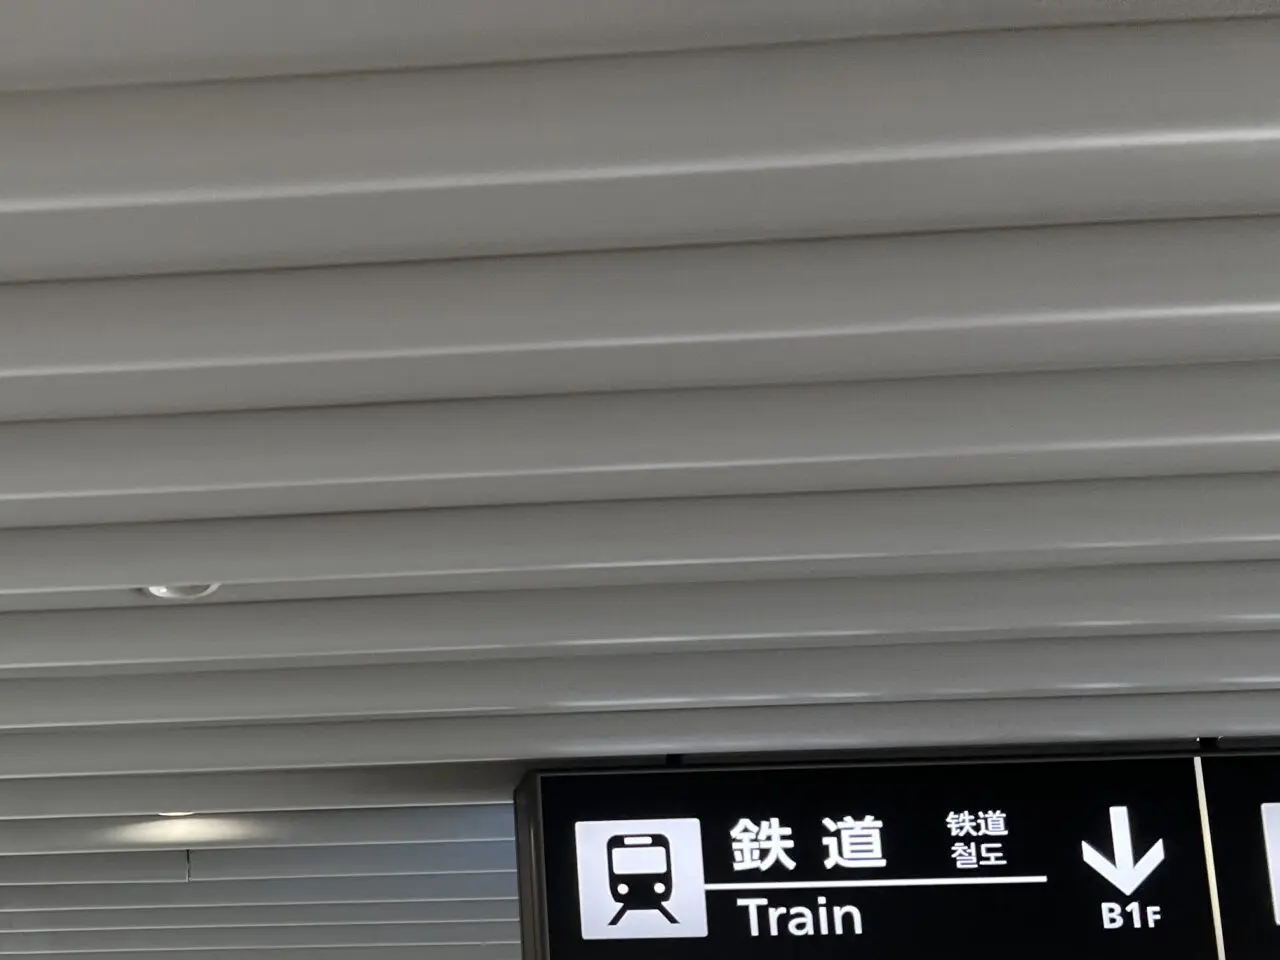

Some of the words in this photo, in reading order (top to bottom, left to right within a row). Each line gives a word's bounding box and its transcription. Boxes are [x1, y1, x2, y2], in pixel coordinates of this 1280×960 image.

[946, 809, 1009, 839] 铁道
[728, 815, 888, 873] 鉄道
[951, 841, 1008, 871] 철도
[736, 895, 864, 938] Train
[1101, 902, 1162, 931] B1F
